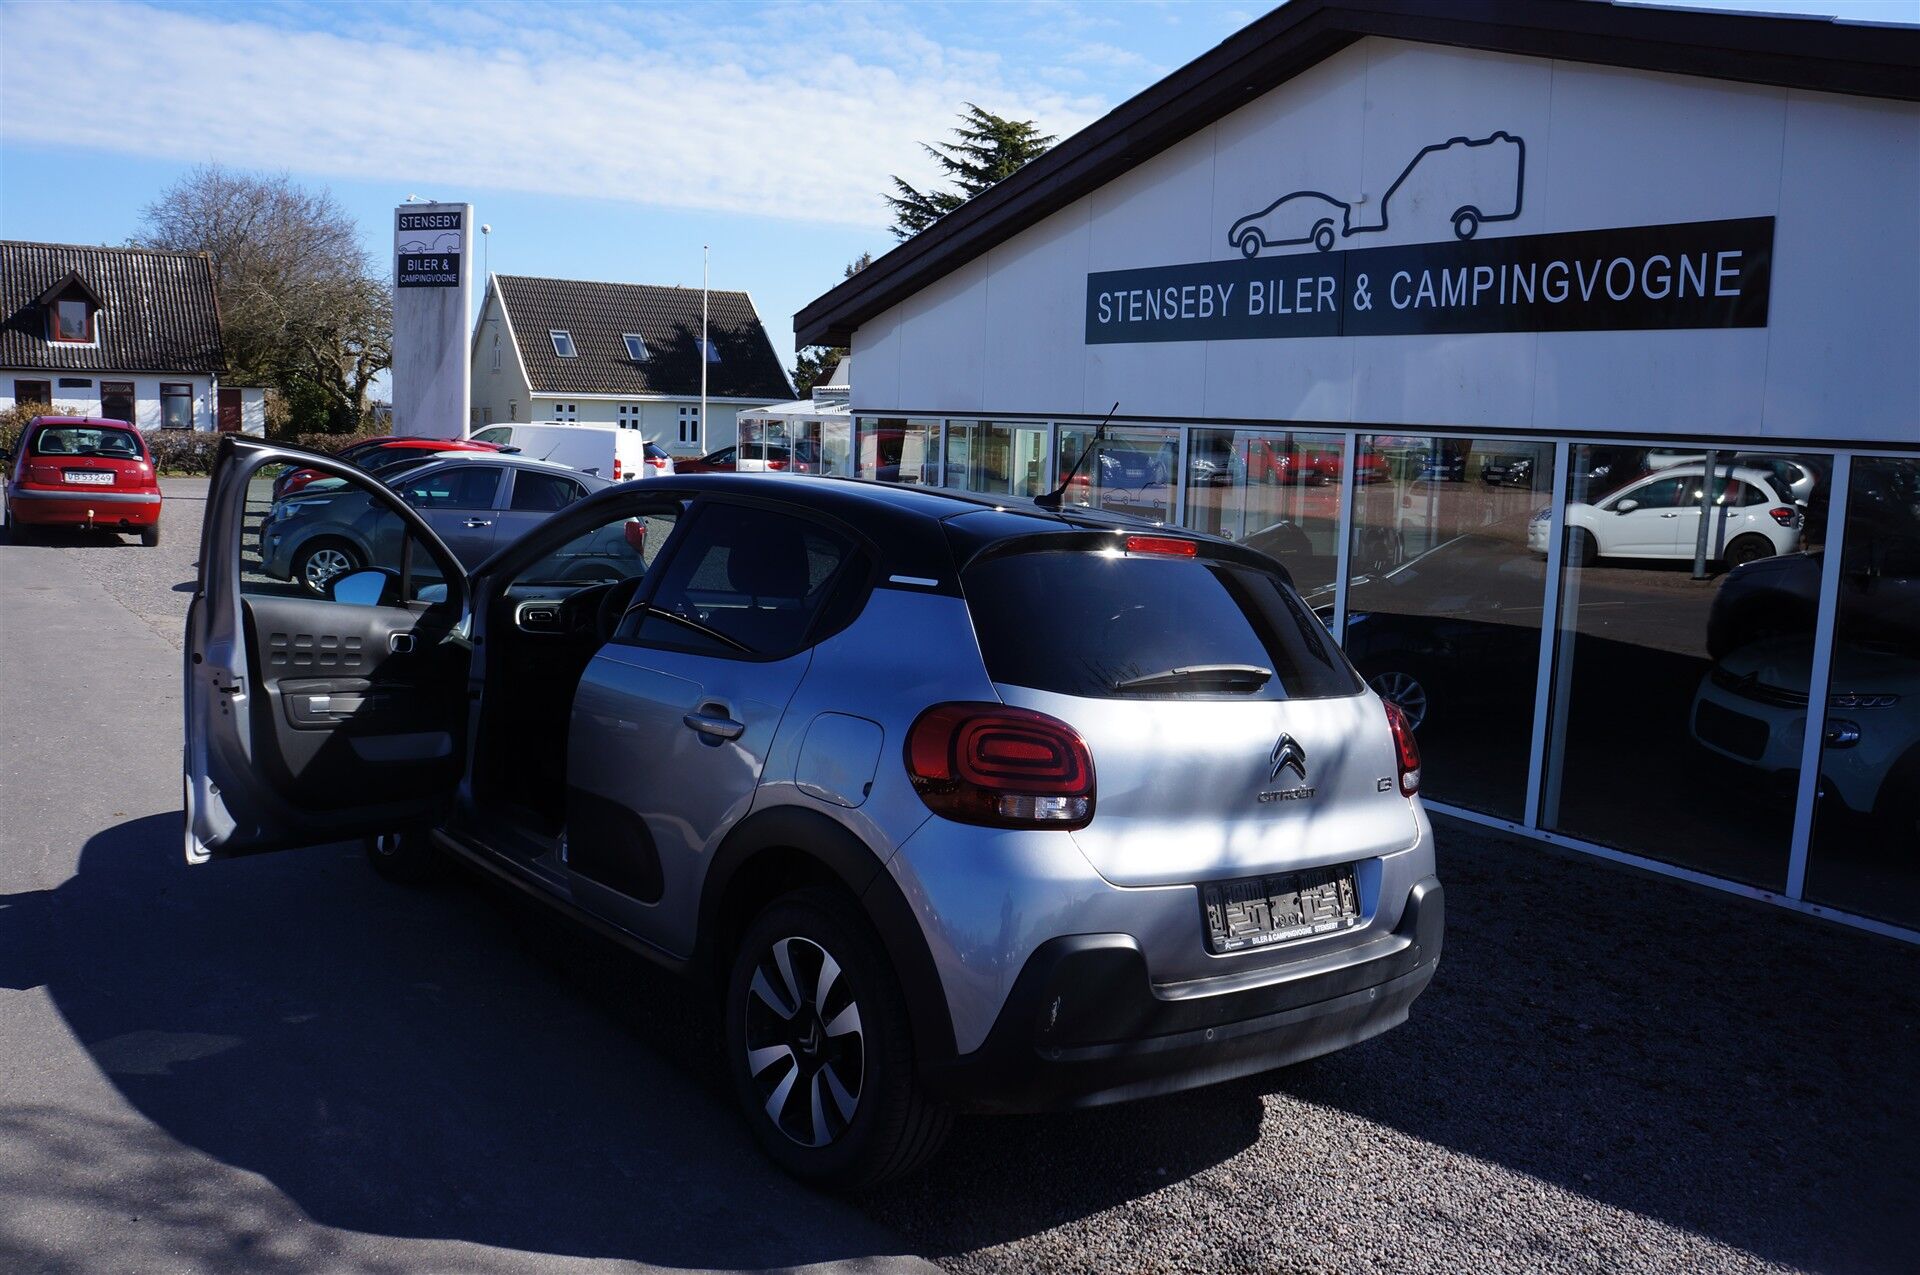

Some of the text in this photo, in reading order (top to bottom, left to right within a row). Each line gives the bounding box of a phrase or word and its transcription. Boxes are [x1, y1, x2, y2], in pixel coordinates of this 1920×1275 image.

[401, 216, 458, 228] STENSEBY
[407, 258, 449, 270] BILER &
[400, 274, 456, 282] CAMPINGVOGNE
[1098, 250, 1743, 324] STENSEBY BILER & CAMPINGVOGNE
[1252, 934, 1268, 945] BILER
[1273, 926, 1312, 941] CAMPINGVOGNE
[1314, 922, 1338, 933] STENSEBY
